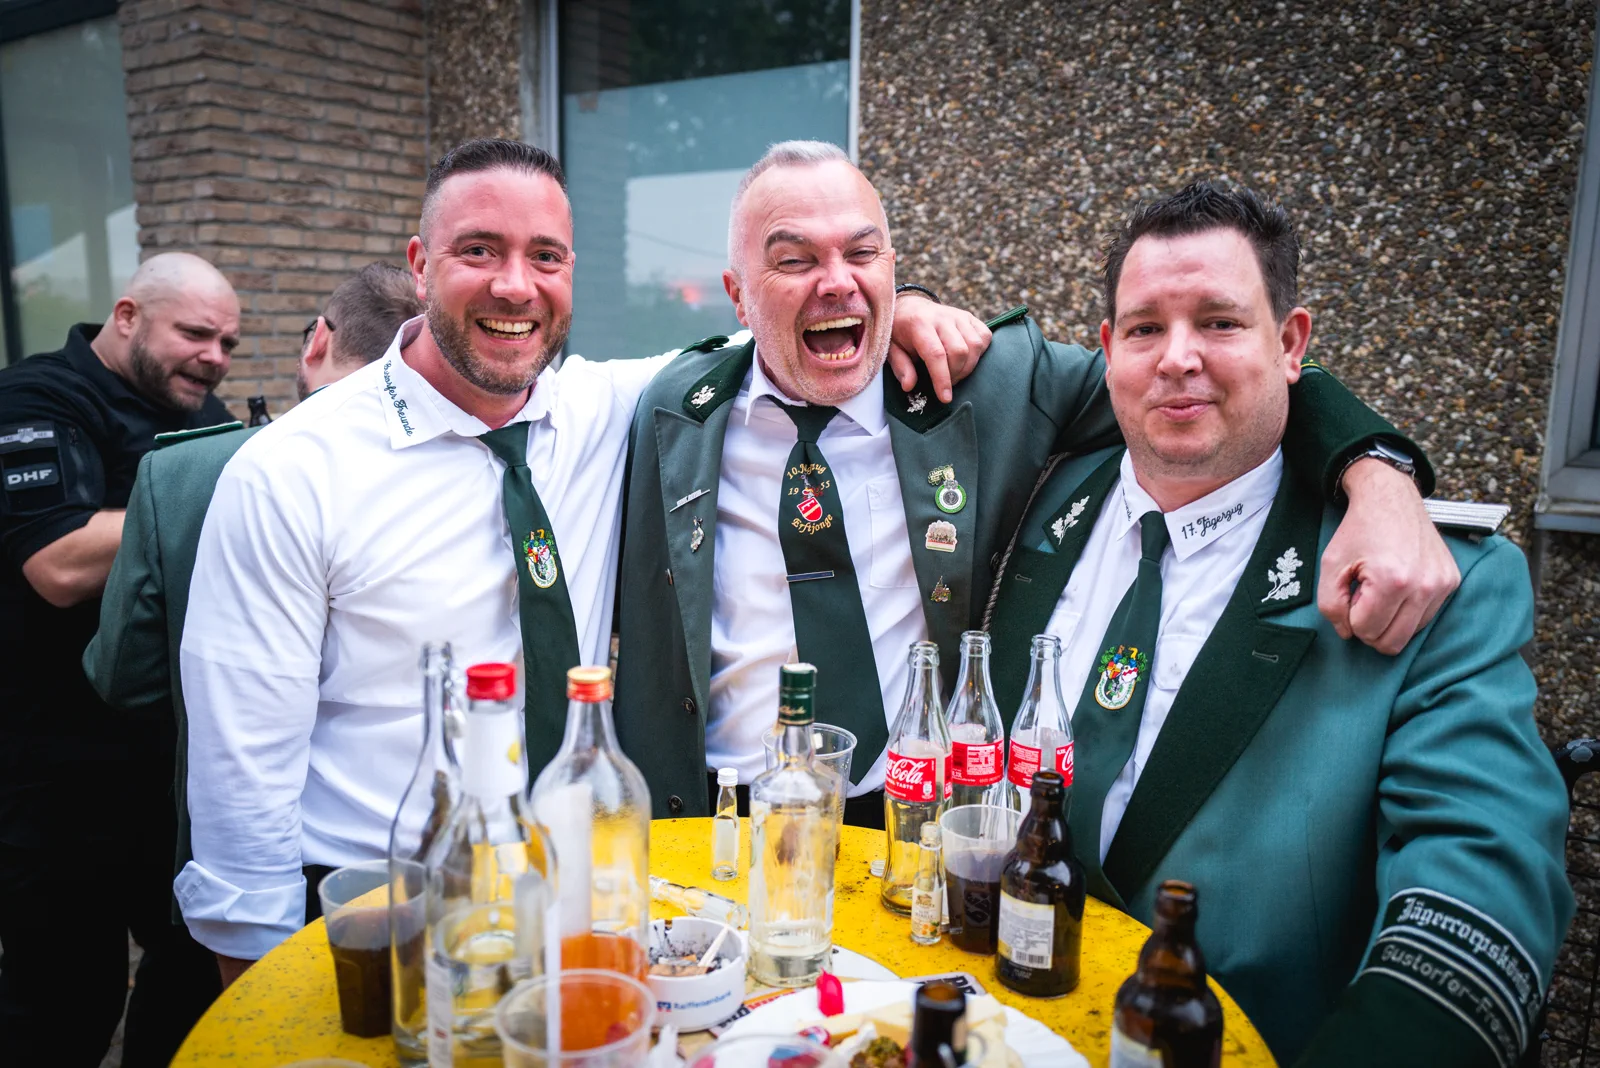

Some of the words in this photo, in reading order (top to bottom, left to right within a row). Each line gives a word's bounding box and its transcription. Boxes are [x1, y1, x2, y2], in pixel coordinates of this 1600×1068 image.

[393, 399, 416, 437] Freunde
[7, 469, 52, 485] DHF
[787, 487, 799, 496] 19
[1181, 522, 1198, 540] 17.
[1196, 502, 1244, 538] Jägerzug
[896, 782, 914, 790] TASTE
